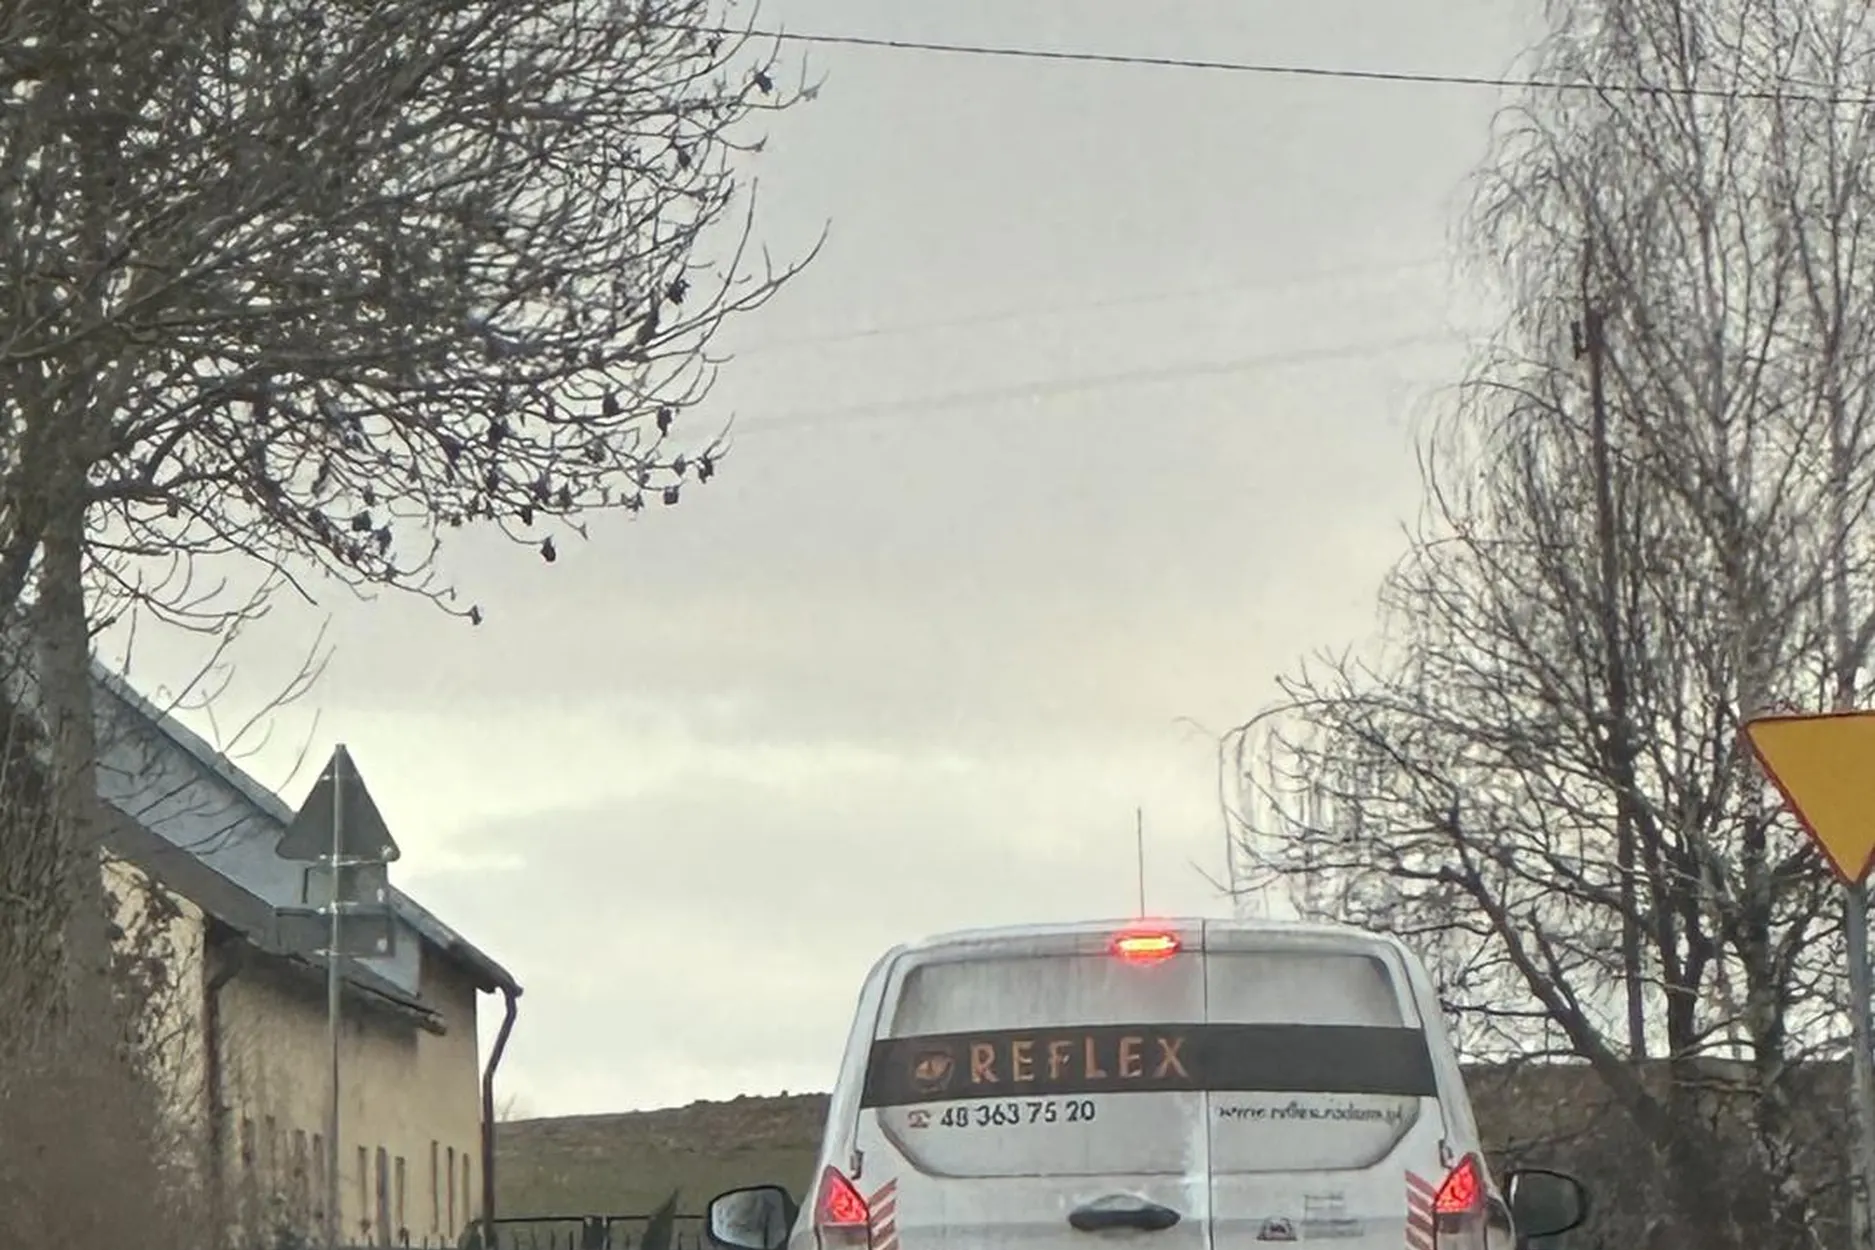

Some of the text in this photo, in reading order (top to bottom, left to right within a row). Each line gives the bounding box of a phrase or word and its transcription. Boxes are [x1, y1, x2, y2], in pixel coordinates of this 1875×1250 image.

[968, 1036, 1191, 1084] REFLEX
[940, 1100, 1096, 1127] 48 363 75 20
